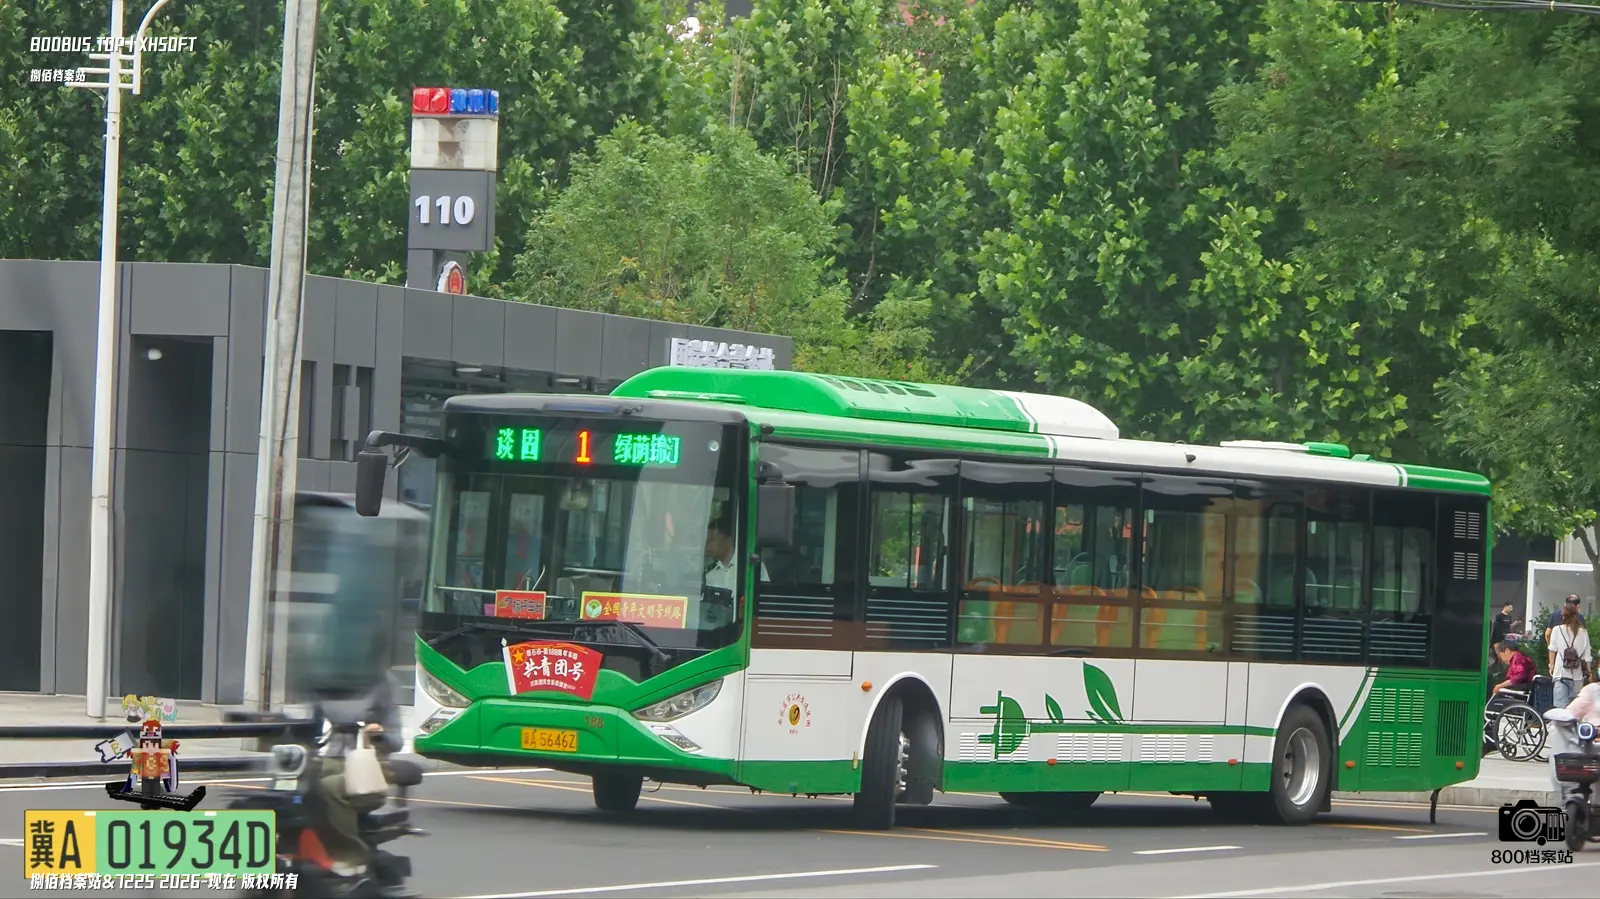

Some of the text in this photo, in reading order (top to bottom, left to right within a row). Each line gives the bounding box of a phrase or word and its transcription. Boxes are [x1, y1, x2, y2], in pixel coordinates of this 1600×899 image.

[415, 195, 475, 225] 110
[576, 430, 590, 463] 1
[523, 655, 584, 681] 共青团号
[584, 715, 604, 728] 188
